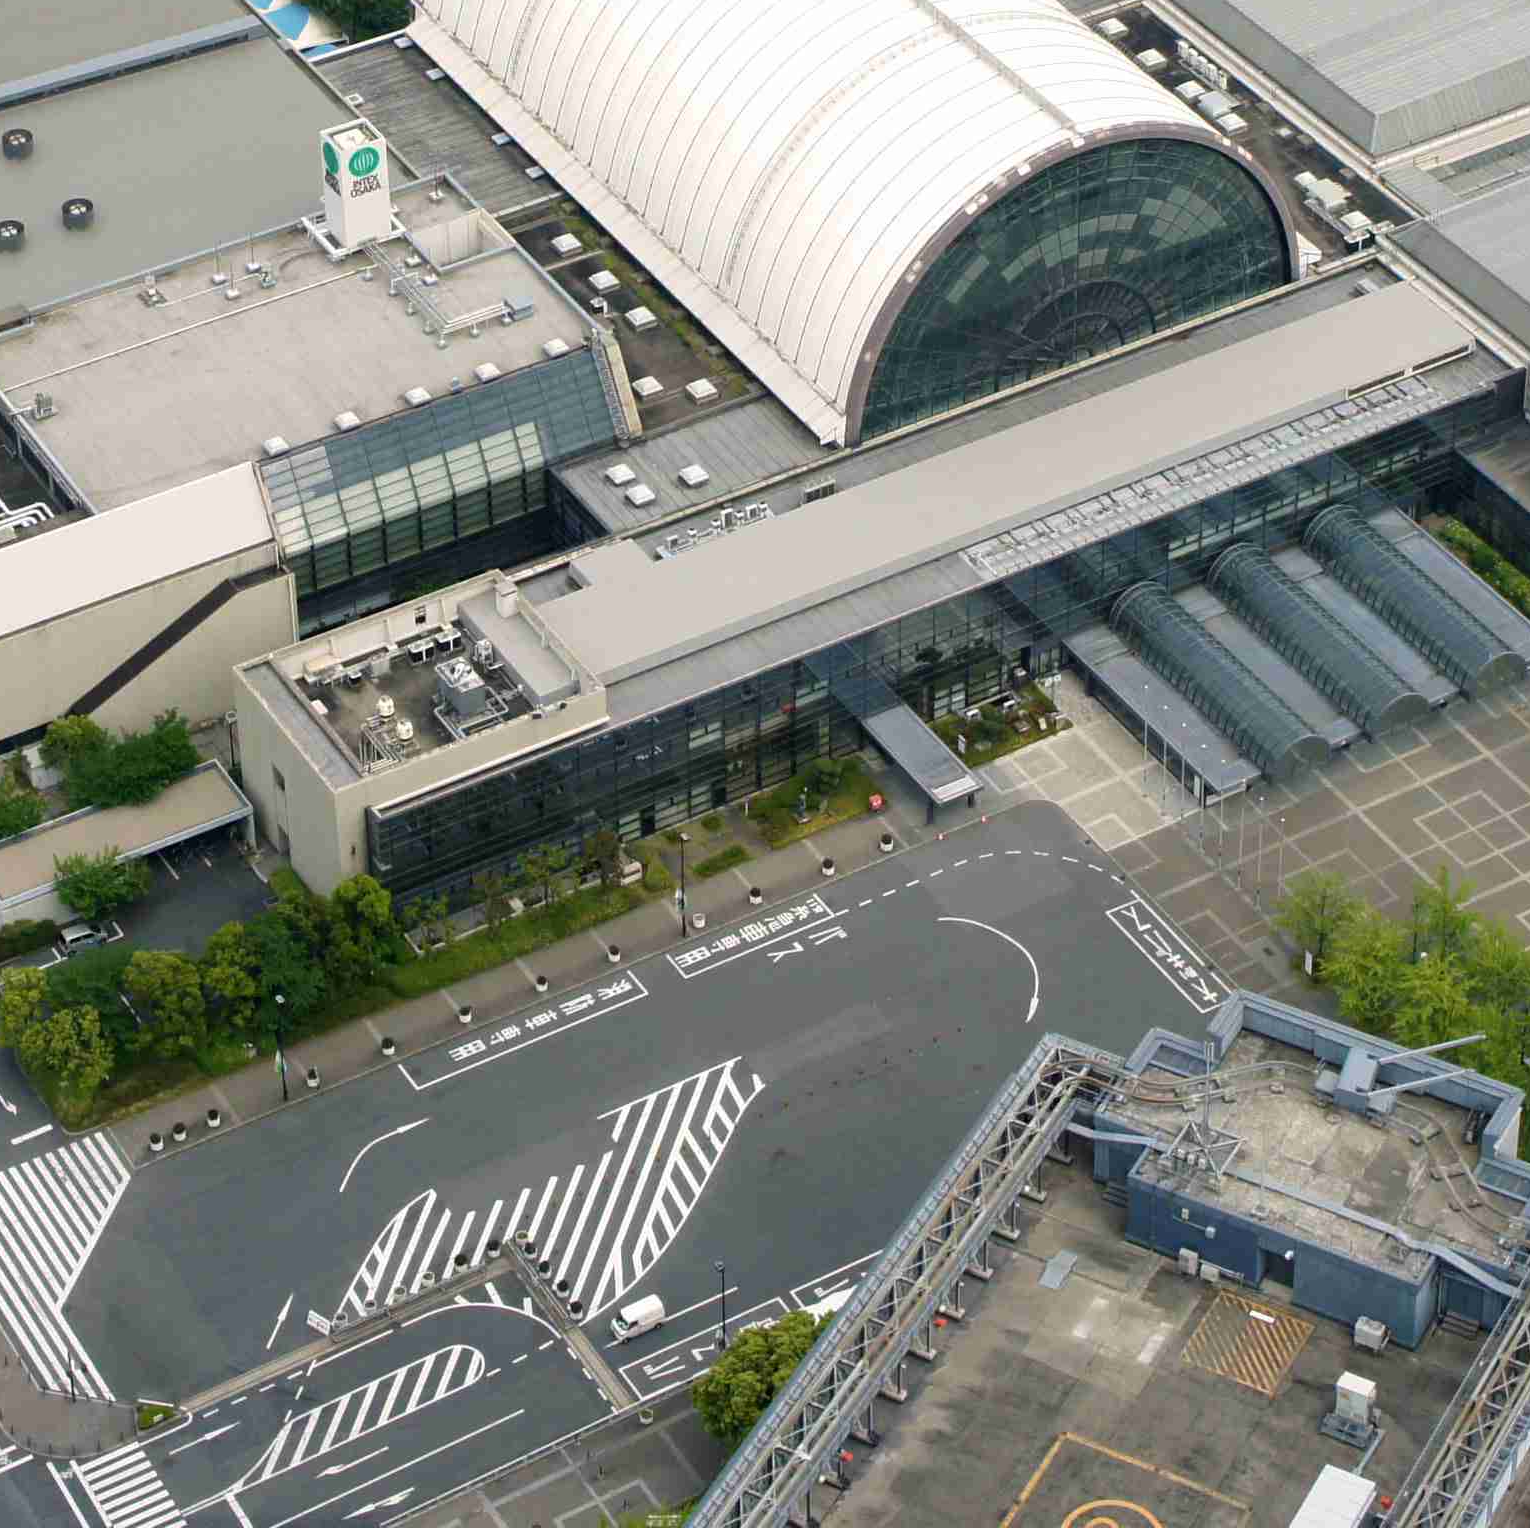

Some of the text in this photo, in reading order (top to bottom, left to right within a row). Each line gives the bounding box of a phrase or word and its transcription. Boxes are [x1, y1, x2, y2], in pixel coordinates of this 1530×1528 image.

[350, 179, 382, 198] OSAKA
[352, 173, 380, 189] INTEX
[767, 925, 848, 963] バス
